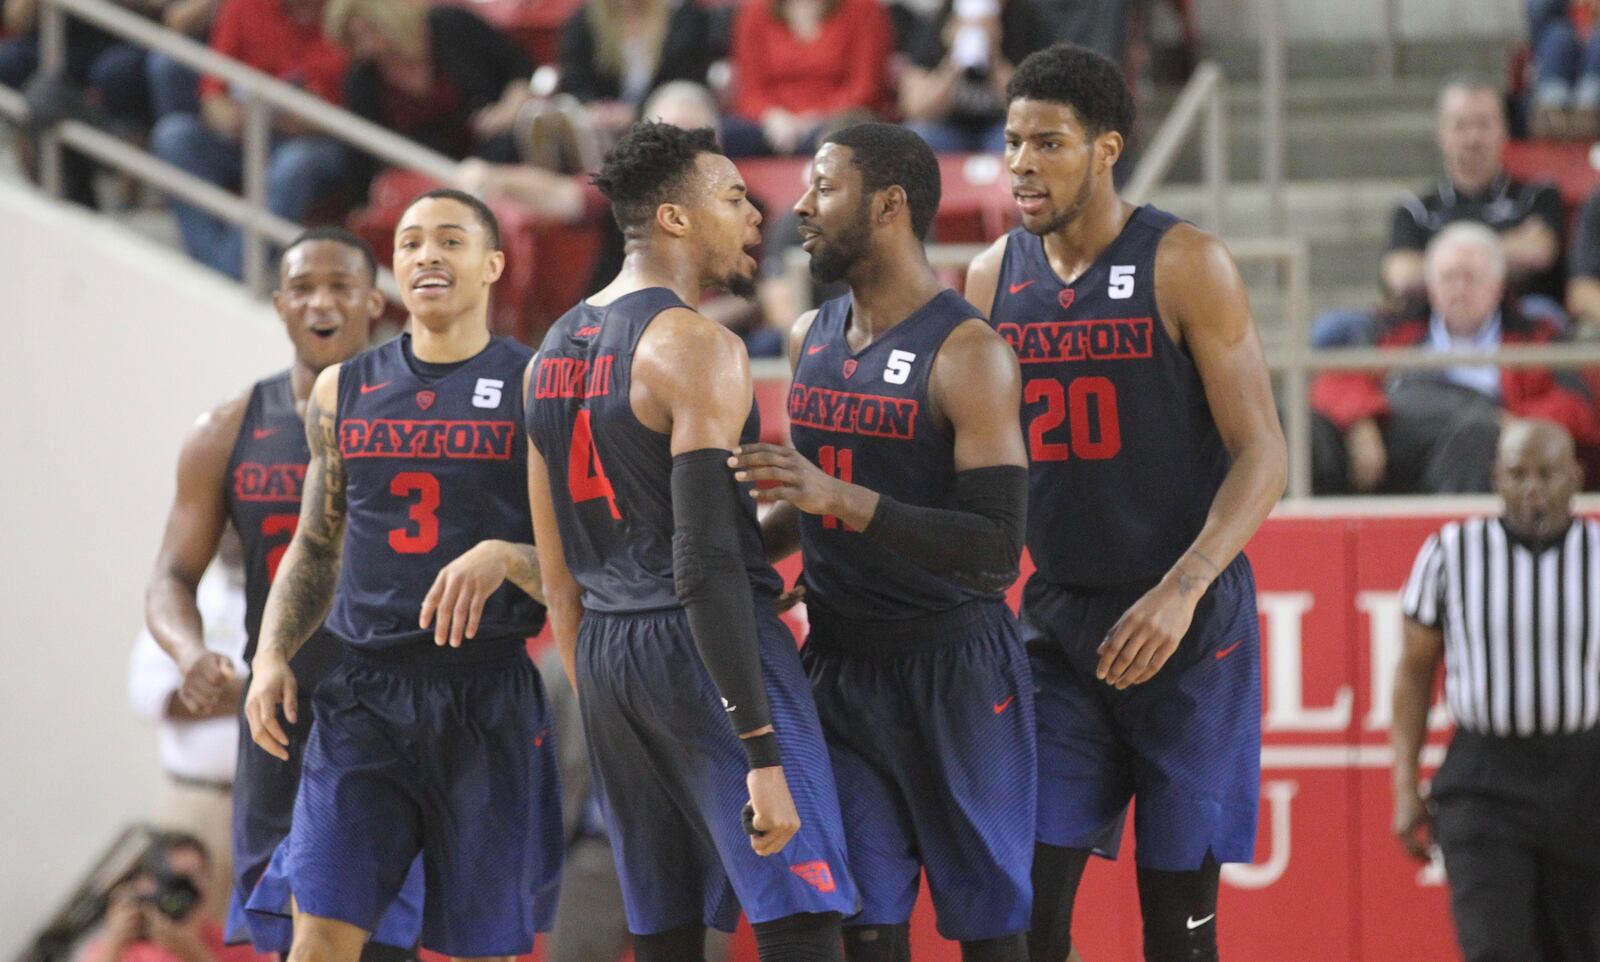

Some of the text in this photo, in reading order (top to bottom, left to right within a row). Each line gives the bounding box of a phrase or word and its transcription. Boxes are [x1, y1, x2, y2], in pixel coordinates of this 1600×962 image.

[1108, 265, 1136, 299] 5
[472, 378, 504, 409] 5
[883, 349, 916, 385] 5
[340, 419, 515, 460] DAYTON
[790, 384, 919, 440] DAYTON
[1024, 376, 1121, 462] 20
[568, 409, 623, 520] 4
[818, 445, 858, 532] 11
[388, 472, 441, 553] 3
